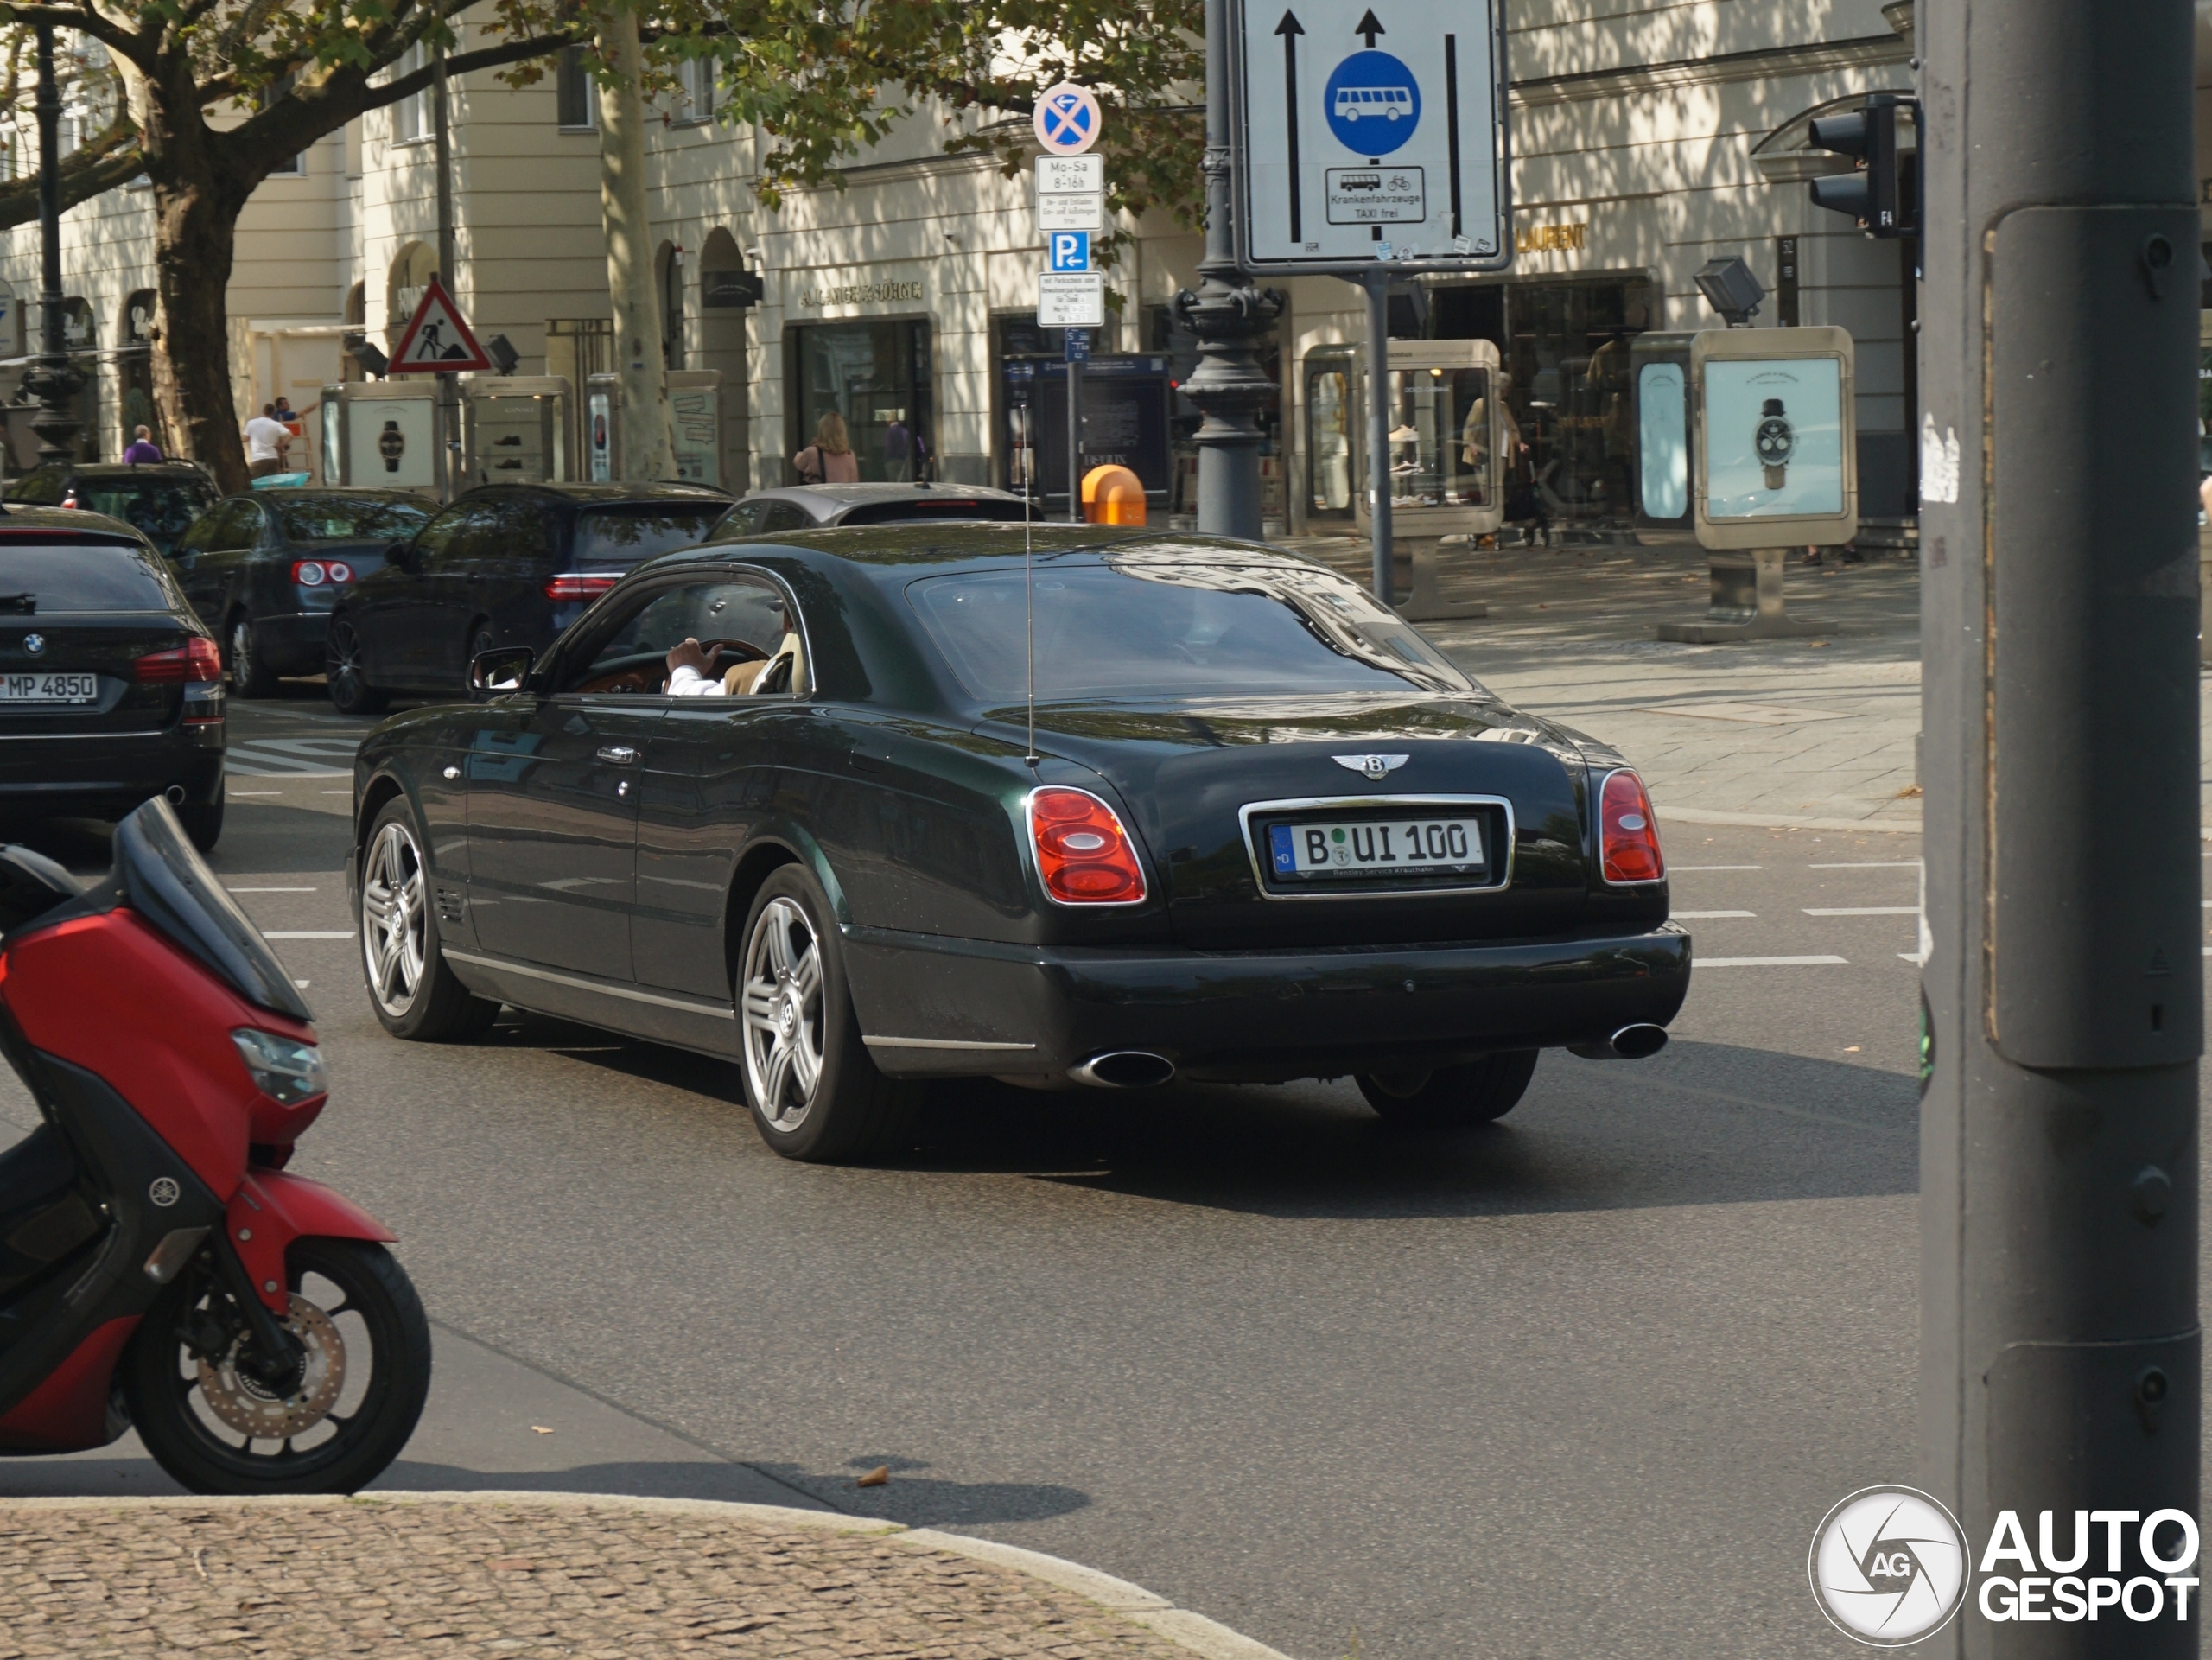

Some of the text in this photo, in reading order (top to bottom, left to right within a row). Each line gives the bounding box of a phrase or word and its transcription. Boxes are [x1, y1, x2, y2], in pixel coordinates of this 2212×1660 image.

[1050, 161, 1088, 172] Mo-Sa
[1331, 194, 1421, 205] Krankenfahrzeuge
[1355, 208, 1398, 218] TAXI frei
[1881, 210, 1893, 226] F4
[1516, 223, 1586, 253] LAURENT
[1056, 234, 1078, 267] P
[816, 286, 860, 306] LANGE
[874, 278, 922, 302] SÖHNE
[8, 676, 93, 696] MP 4850
[1366, 758, 1383, 772] B
[1305, 824, 1468, 864] B UI 100
[1281, 854, 1289, 863] D
